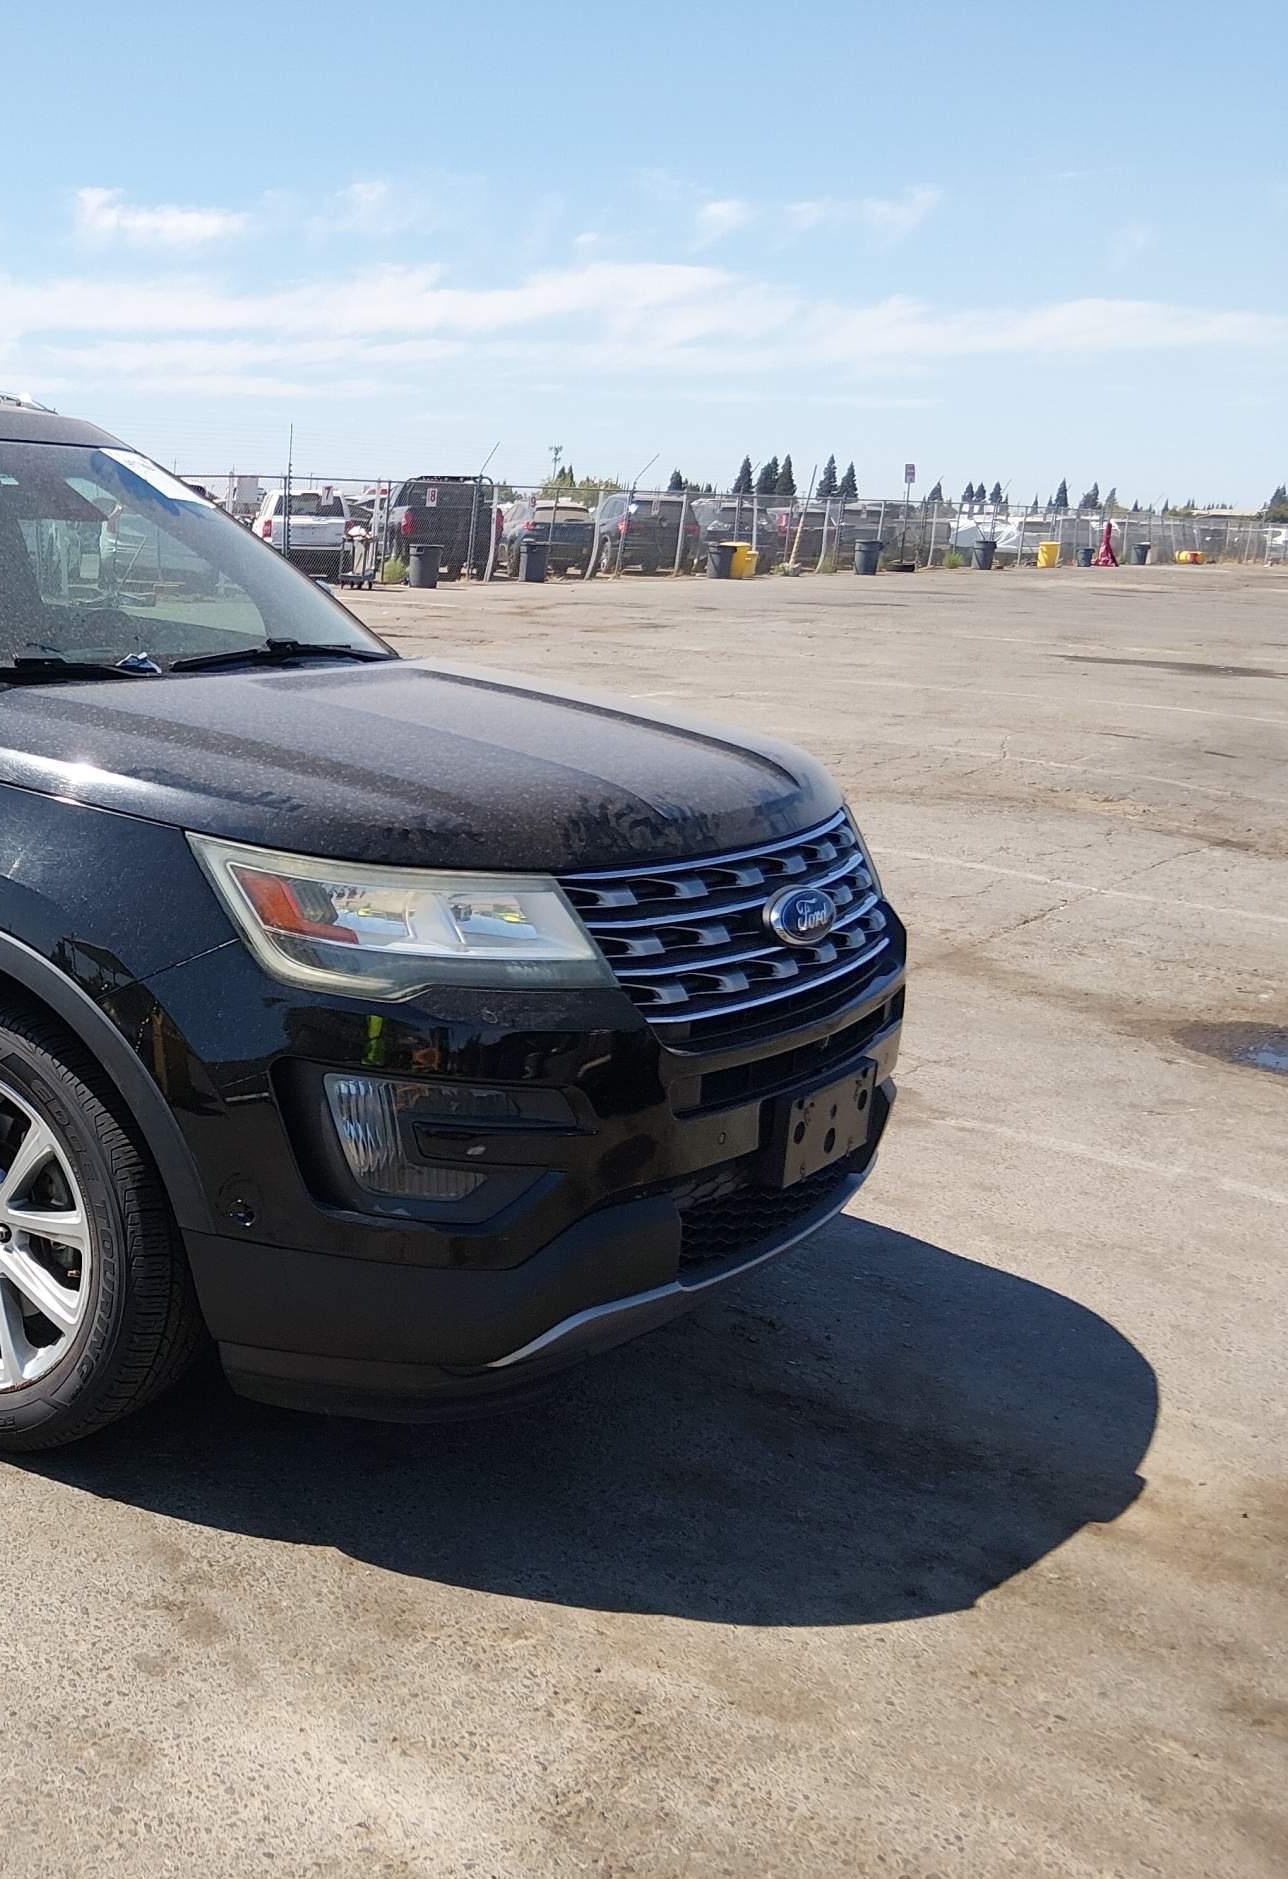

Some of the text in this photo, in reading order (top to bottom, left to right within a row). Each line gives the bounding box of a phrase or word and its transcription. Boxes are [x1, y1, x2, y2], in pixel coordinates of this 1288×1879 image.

[324, 485, 333, 500] 7
[429, 489, 437, 503] 8
[795, 898, 827, 932] Ford
